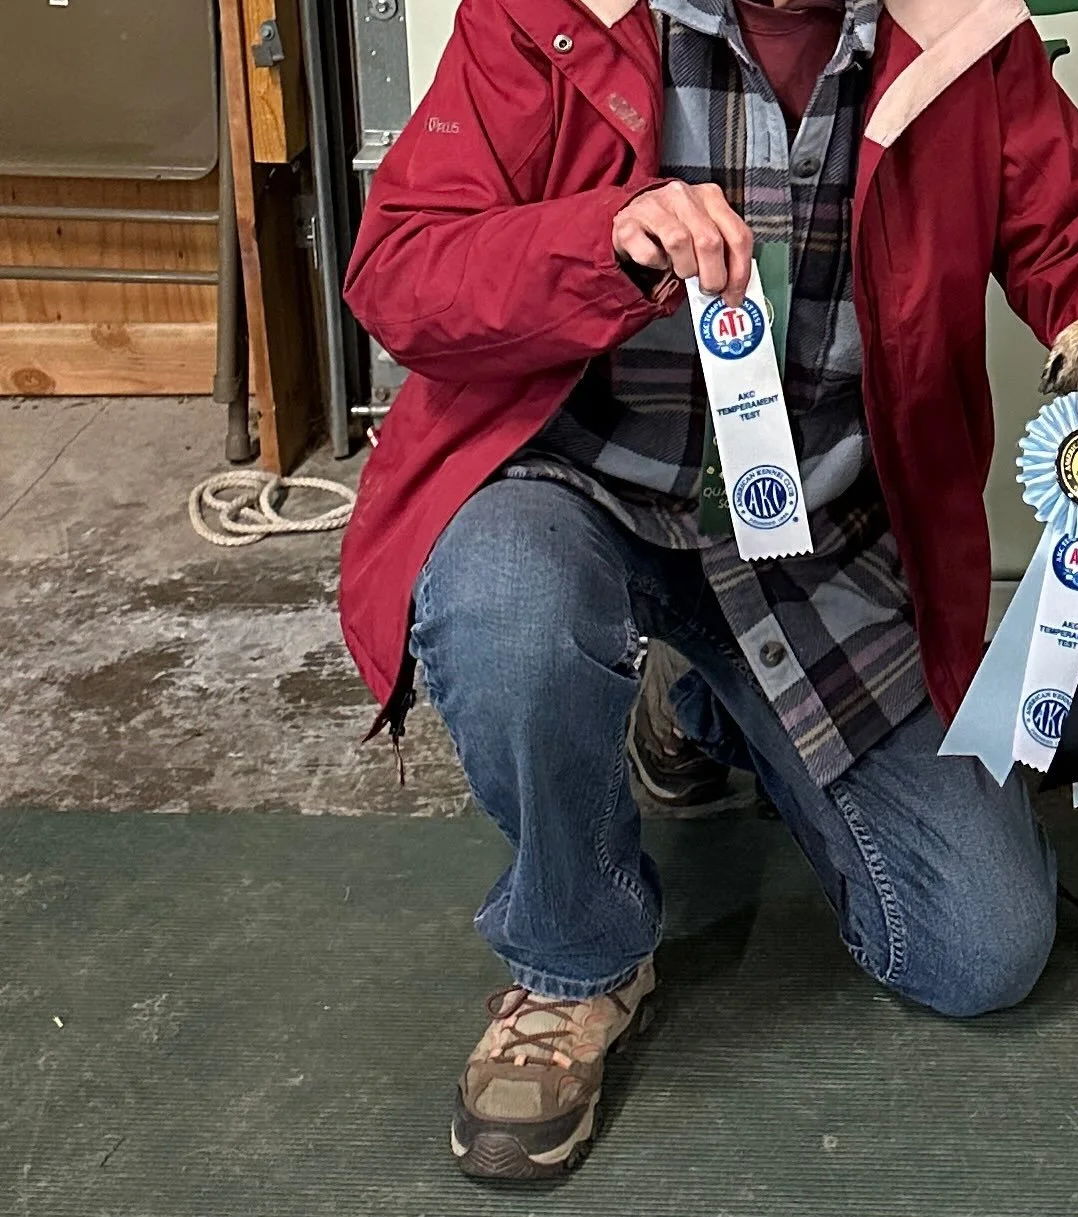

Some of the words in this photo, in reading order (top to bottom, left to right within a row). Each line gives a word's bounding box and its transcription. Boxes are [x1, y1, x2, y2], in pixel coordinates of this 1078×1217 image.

[718, 309, 746, 338] ATT
[738, 390, 756, 402] AKC
[716, 394, 779, 416] TEMPERAMENT
[739, 409, 761, 422] TEST
[748, 478, 786, 519] AKC
[1057, 638, 1078, 650] TEST
